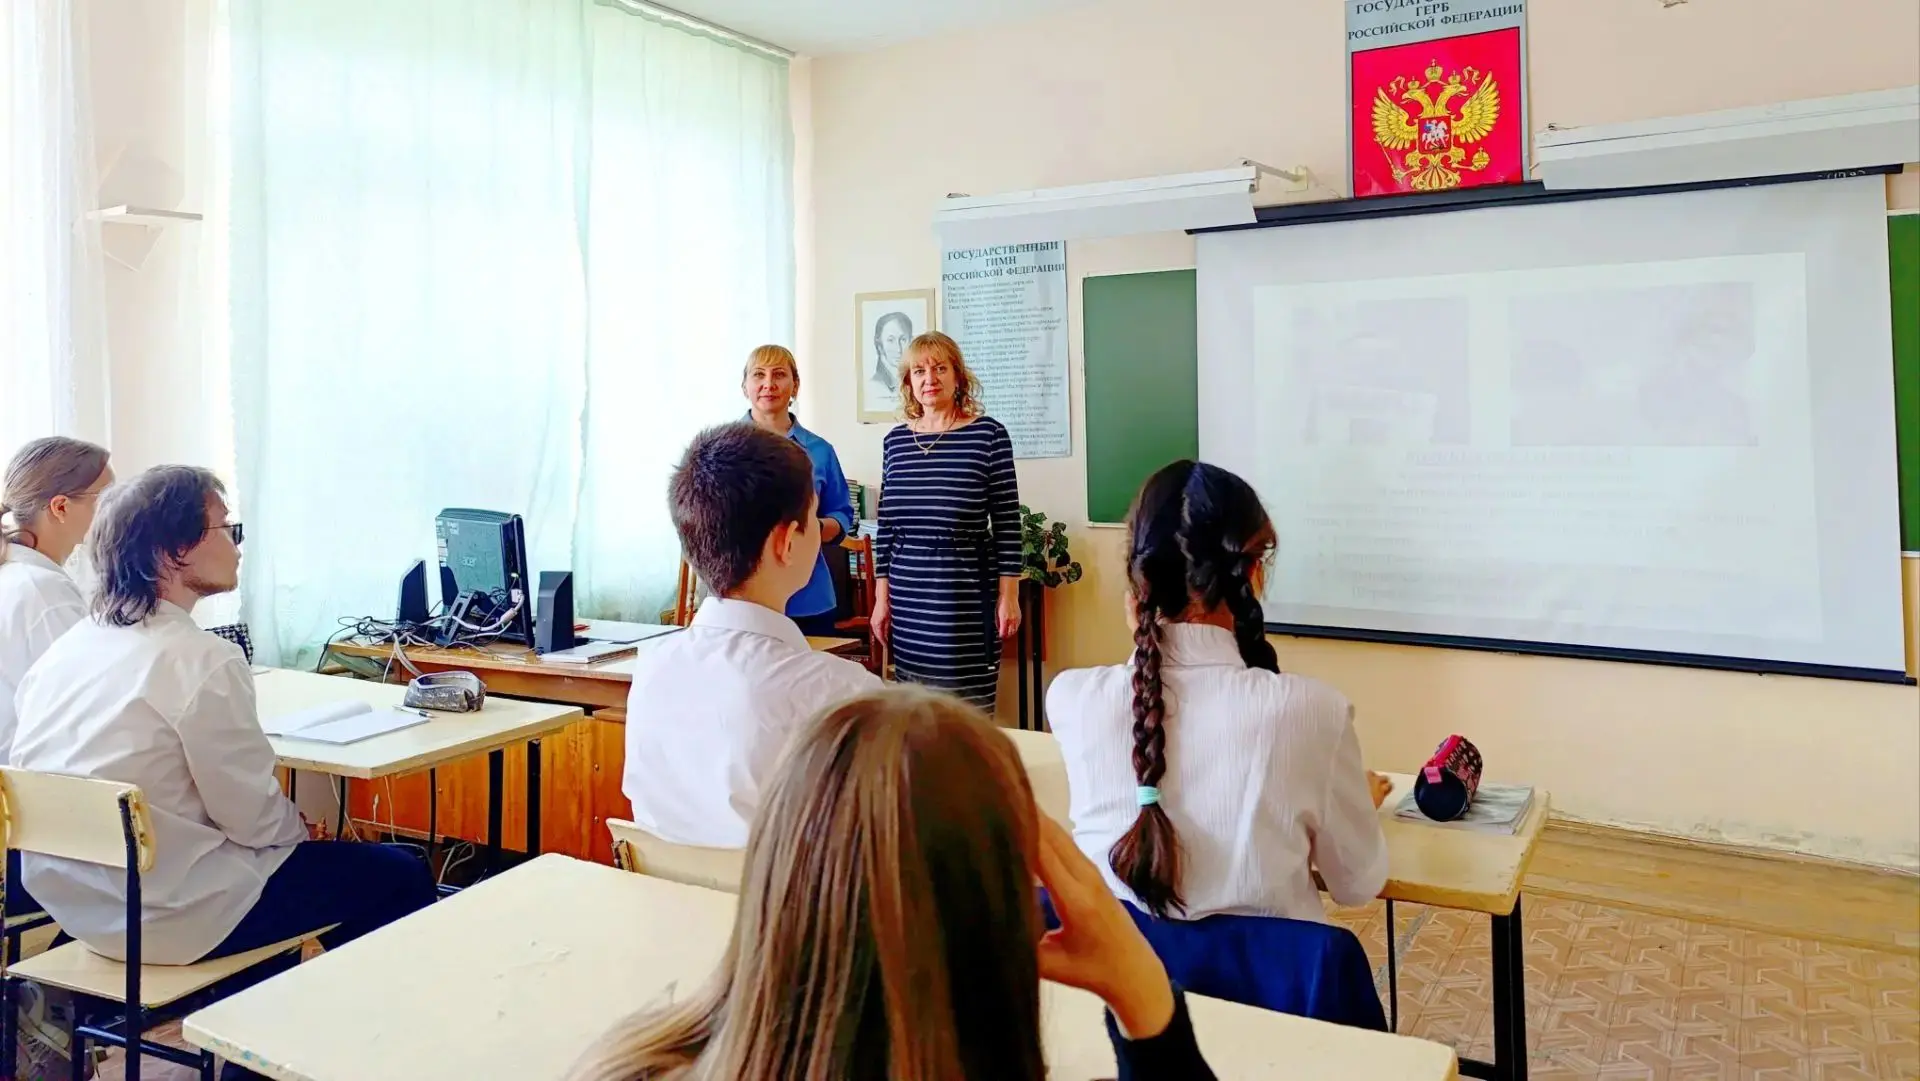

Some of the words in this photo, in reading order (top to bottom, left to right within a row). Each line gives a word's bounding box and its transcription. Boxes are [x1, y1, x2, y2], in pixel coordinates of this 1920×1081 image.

[1416, 2, 1449, 17] ГЕРБ
[1348, 16, 1435, 40] РОССИЙСКОЙ
[1440, 4, 1524, 25] ФЕДЕРАЦИИ
[947, 241, 1059, 260] ГОСУДАРСТВЕННЫЙ
[985, 256, 1017, 267] ГИМН
[942, 267, 1003, 282] РОССИЙСКОЙ
[1006, 263, 1065, 275] ФЕДЕРАЦИИ
